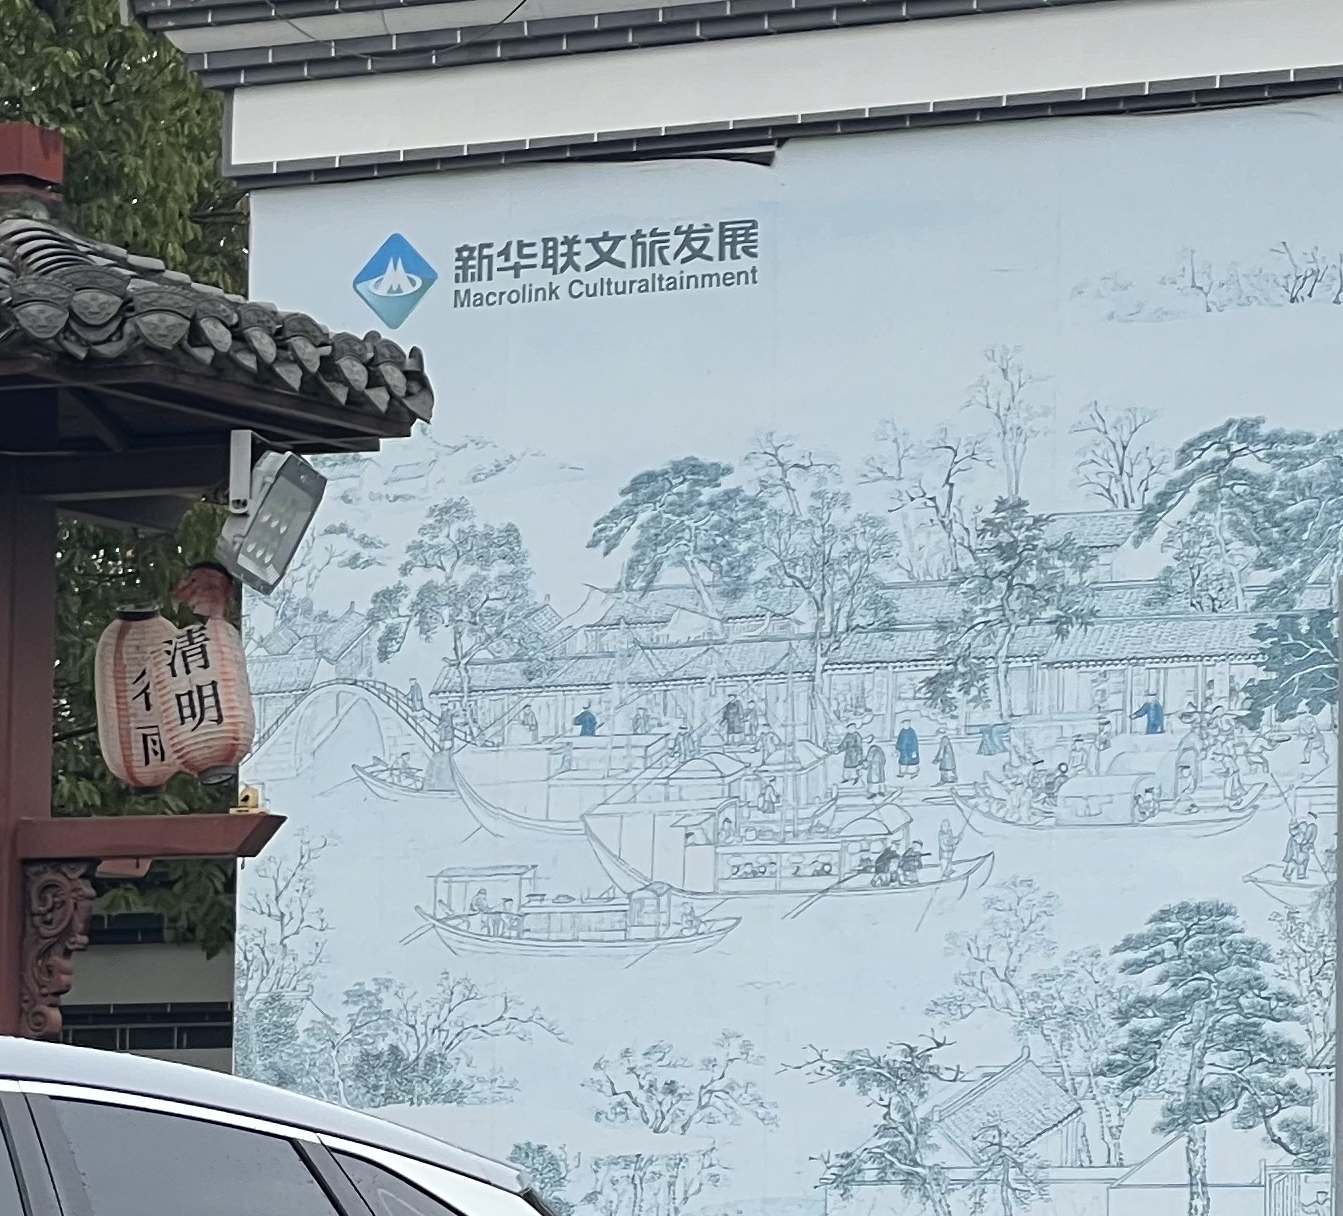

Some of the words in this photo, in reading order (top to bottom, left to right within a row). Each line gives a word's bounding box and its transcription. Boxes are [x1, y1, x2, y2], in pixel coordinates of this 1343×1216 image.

[453, 219, 759, 284] 新华联文旅发展
[453, 281, 560, 309] Macrolink
[569, 266, 759, 299] Culturaltainment
[163, 625, 224, 733] 清明
